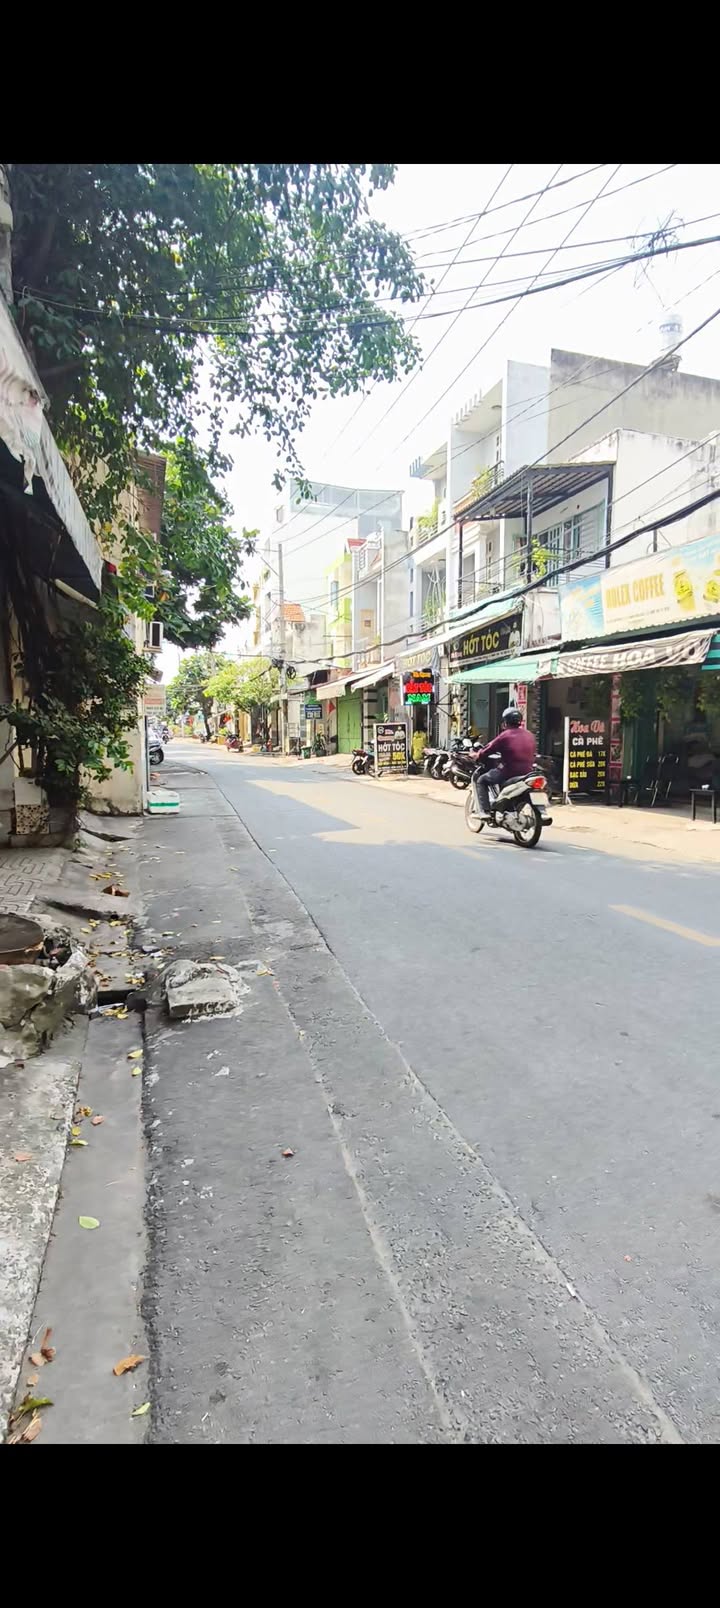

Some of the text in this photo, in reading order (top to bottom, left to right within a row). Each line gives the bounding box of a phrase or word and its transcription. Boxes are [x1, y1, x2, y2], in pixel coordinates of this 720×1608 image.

[632, 574, 664, 602] COFFEE
[463, 628, 500, 656] HỚT TÓC
[567, 655, 609, 670] COFFEE
[613, 648, 656, 665] HOA
[378, 740, 405, 752] HỚT TÓC
[572, 735, 604, 746] CÀ PHÊ
